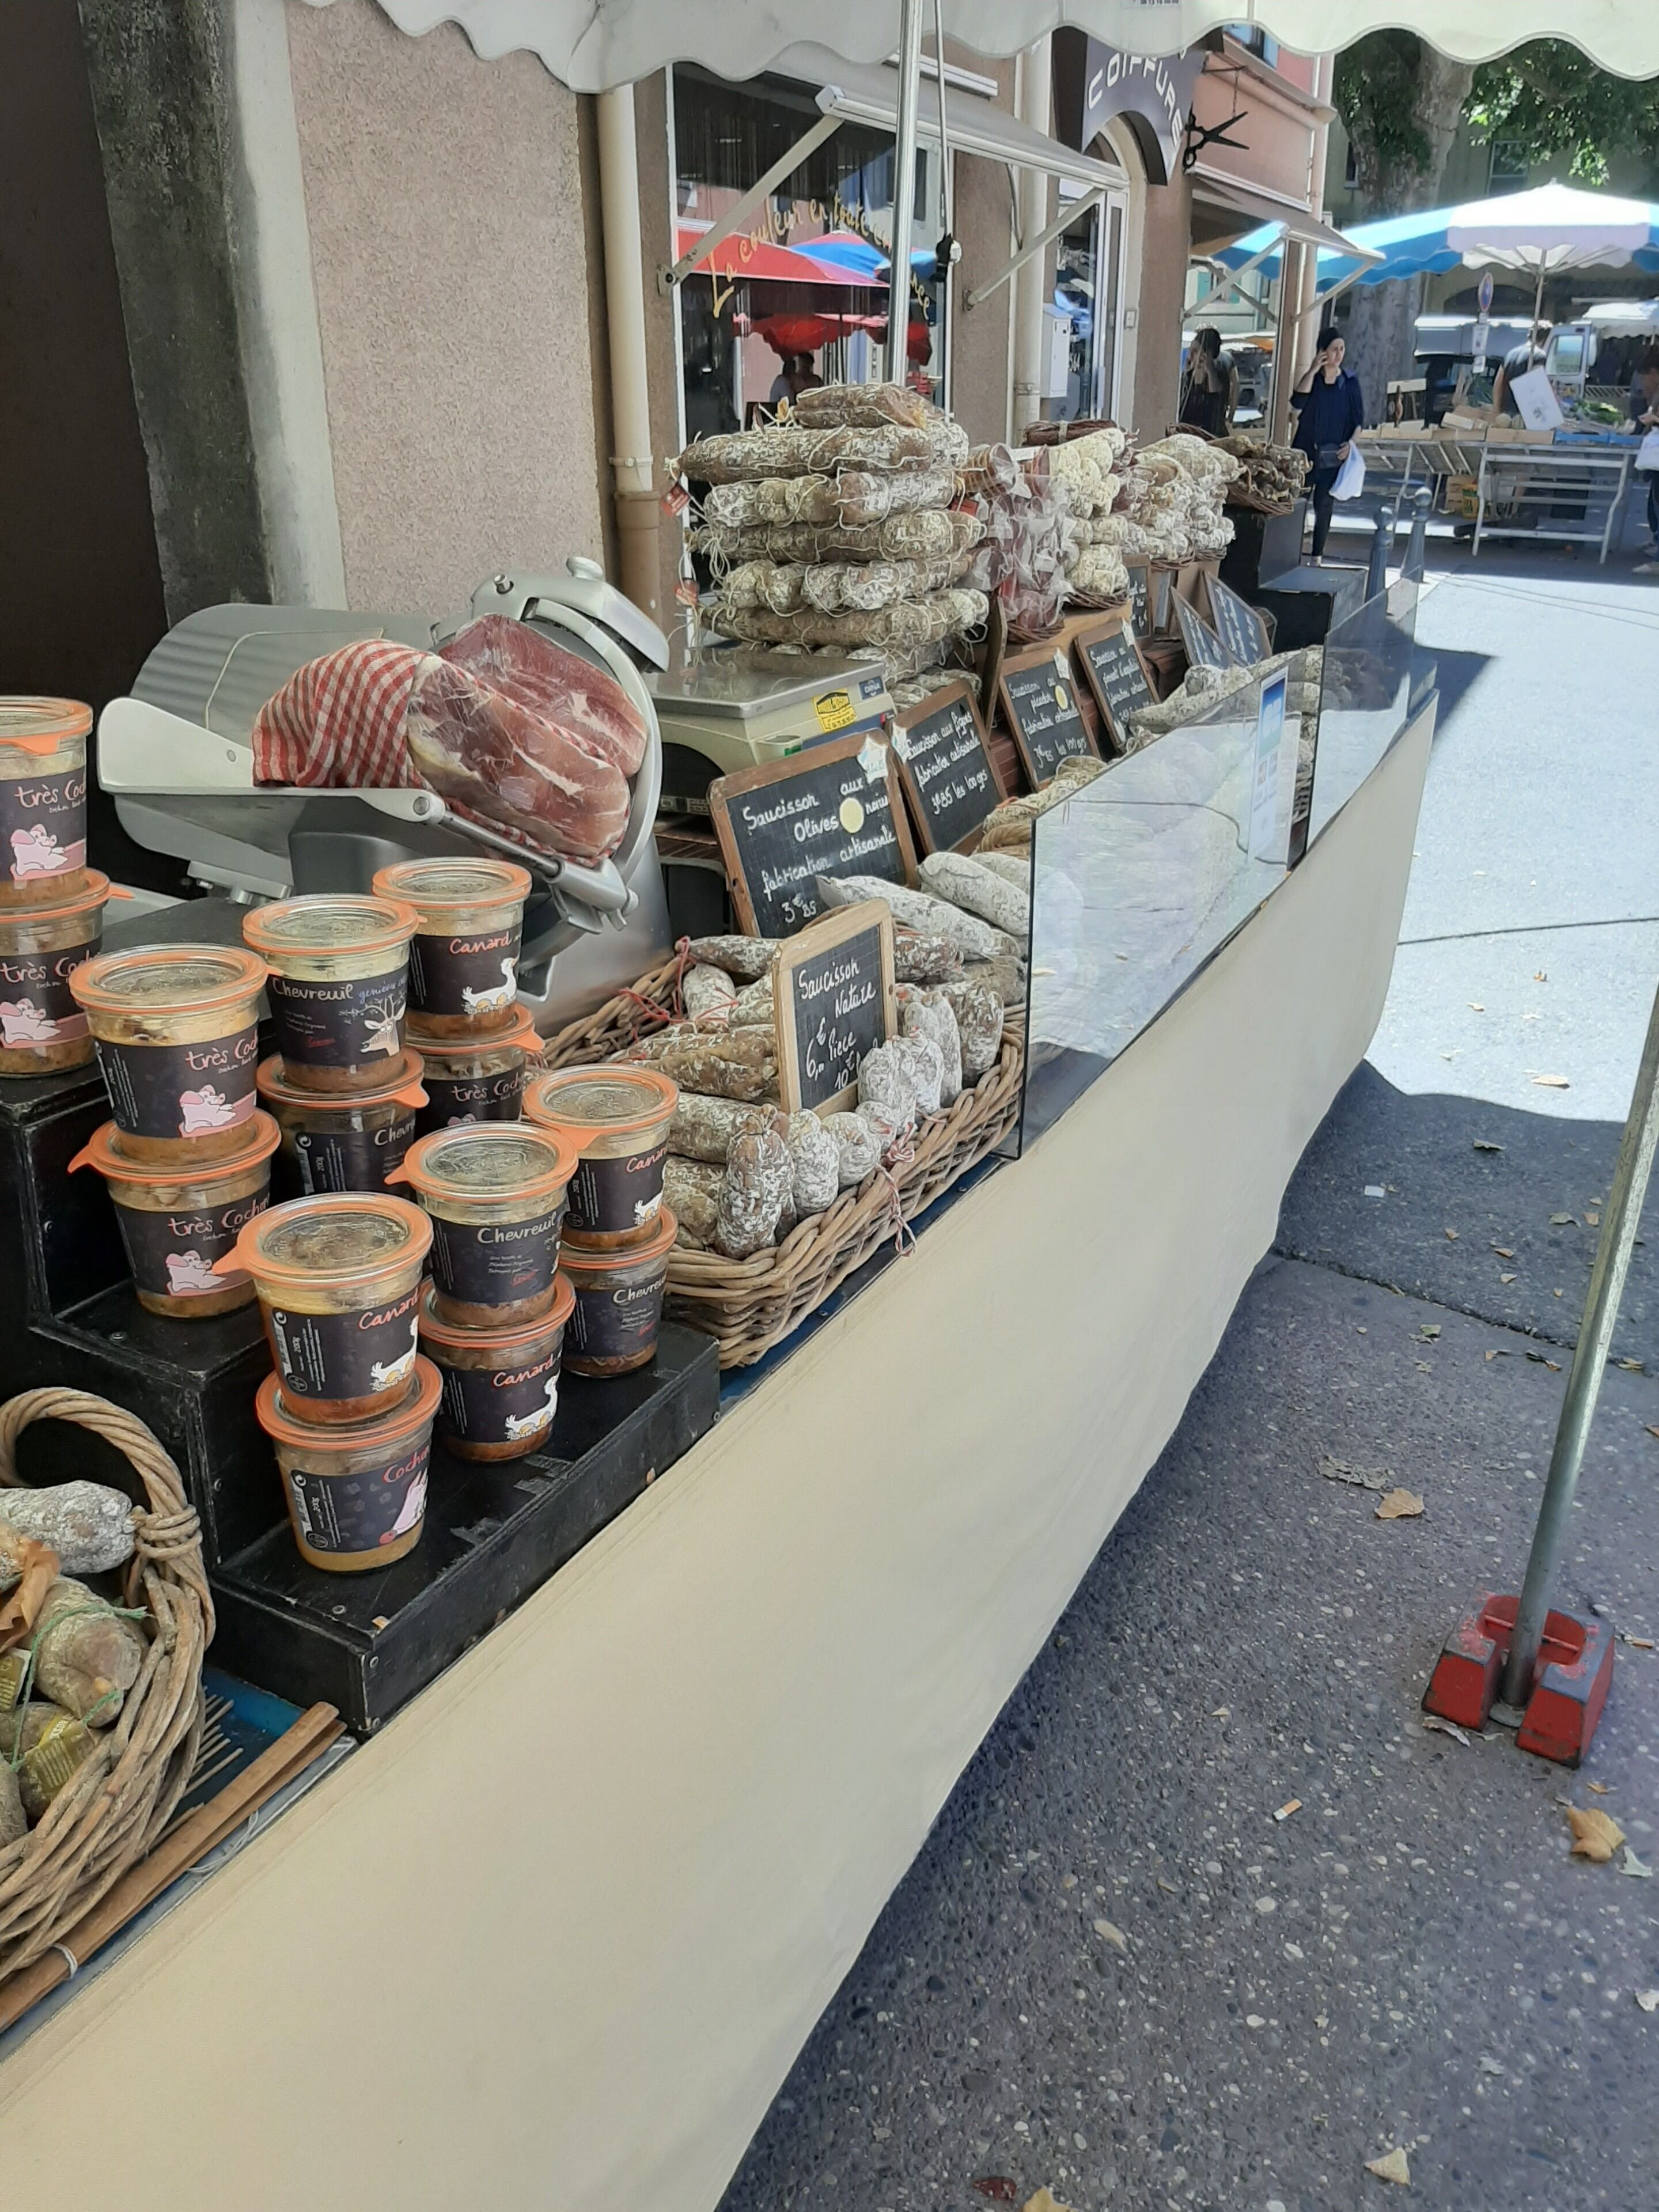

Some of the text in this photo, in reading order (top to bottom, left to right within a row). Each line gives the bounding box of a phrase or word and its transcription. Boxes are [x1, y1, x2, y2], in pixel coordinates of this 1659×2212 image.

[1088, 52, 1183, 147] COIFFURE
[707, 250, 737, 319] La
[739, 196, 804, 263] couleur
[809, 199, 828, 224] en
[833, 191, 869, 236] toute
[906, 732, 942, 760] Saucisson
[940, 722, 954, 738] aux
[14, 783, 59, 808] très
[743, 776, 864, 831] Saucisson aux
[952, 781, 966, 800] les
[794, 815, 839, 842] Olives
[761, 825, 896, 902] fabrication artisanale
[449, 931, 513, 954] Canard
[0, 961, 47, 983] très
[799, 957, 860, 999] Saucisson
[272, 978, 354, 1001] Chevreuil
[835, 982, 877, 1018] Nature
[185, 1047, 229, 1071] très
[451, 1084, 488, 1102] très
[374, 1120, 415, 1146] Chevr
[626, 1147, 668, 1173] Canar
[168, 1216, 214, 1236] très
[477, 1211, 558, 1244] Chevreuil
[358, 1287, 419, 1330] Canard
[493, 1353, 556, 1387] Canard
